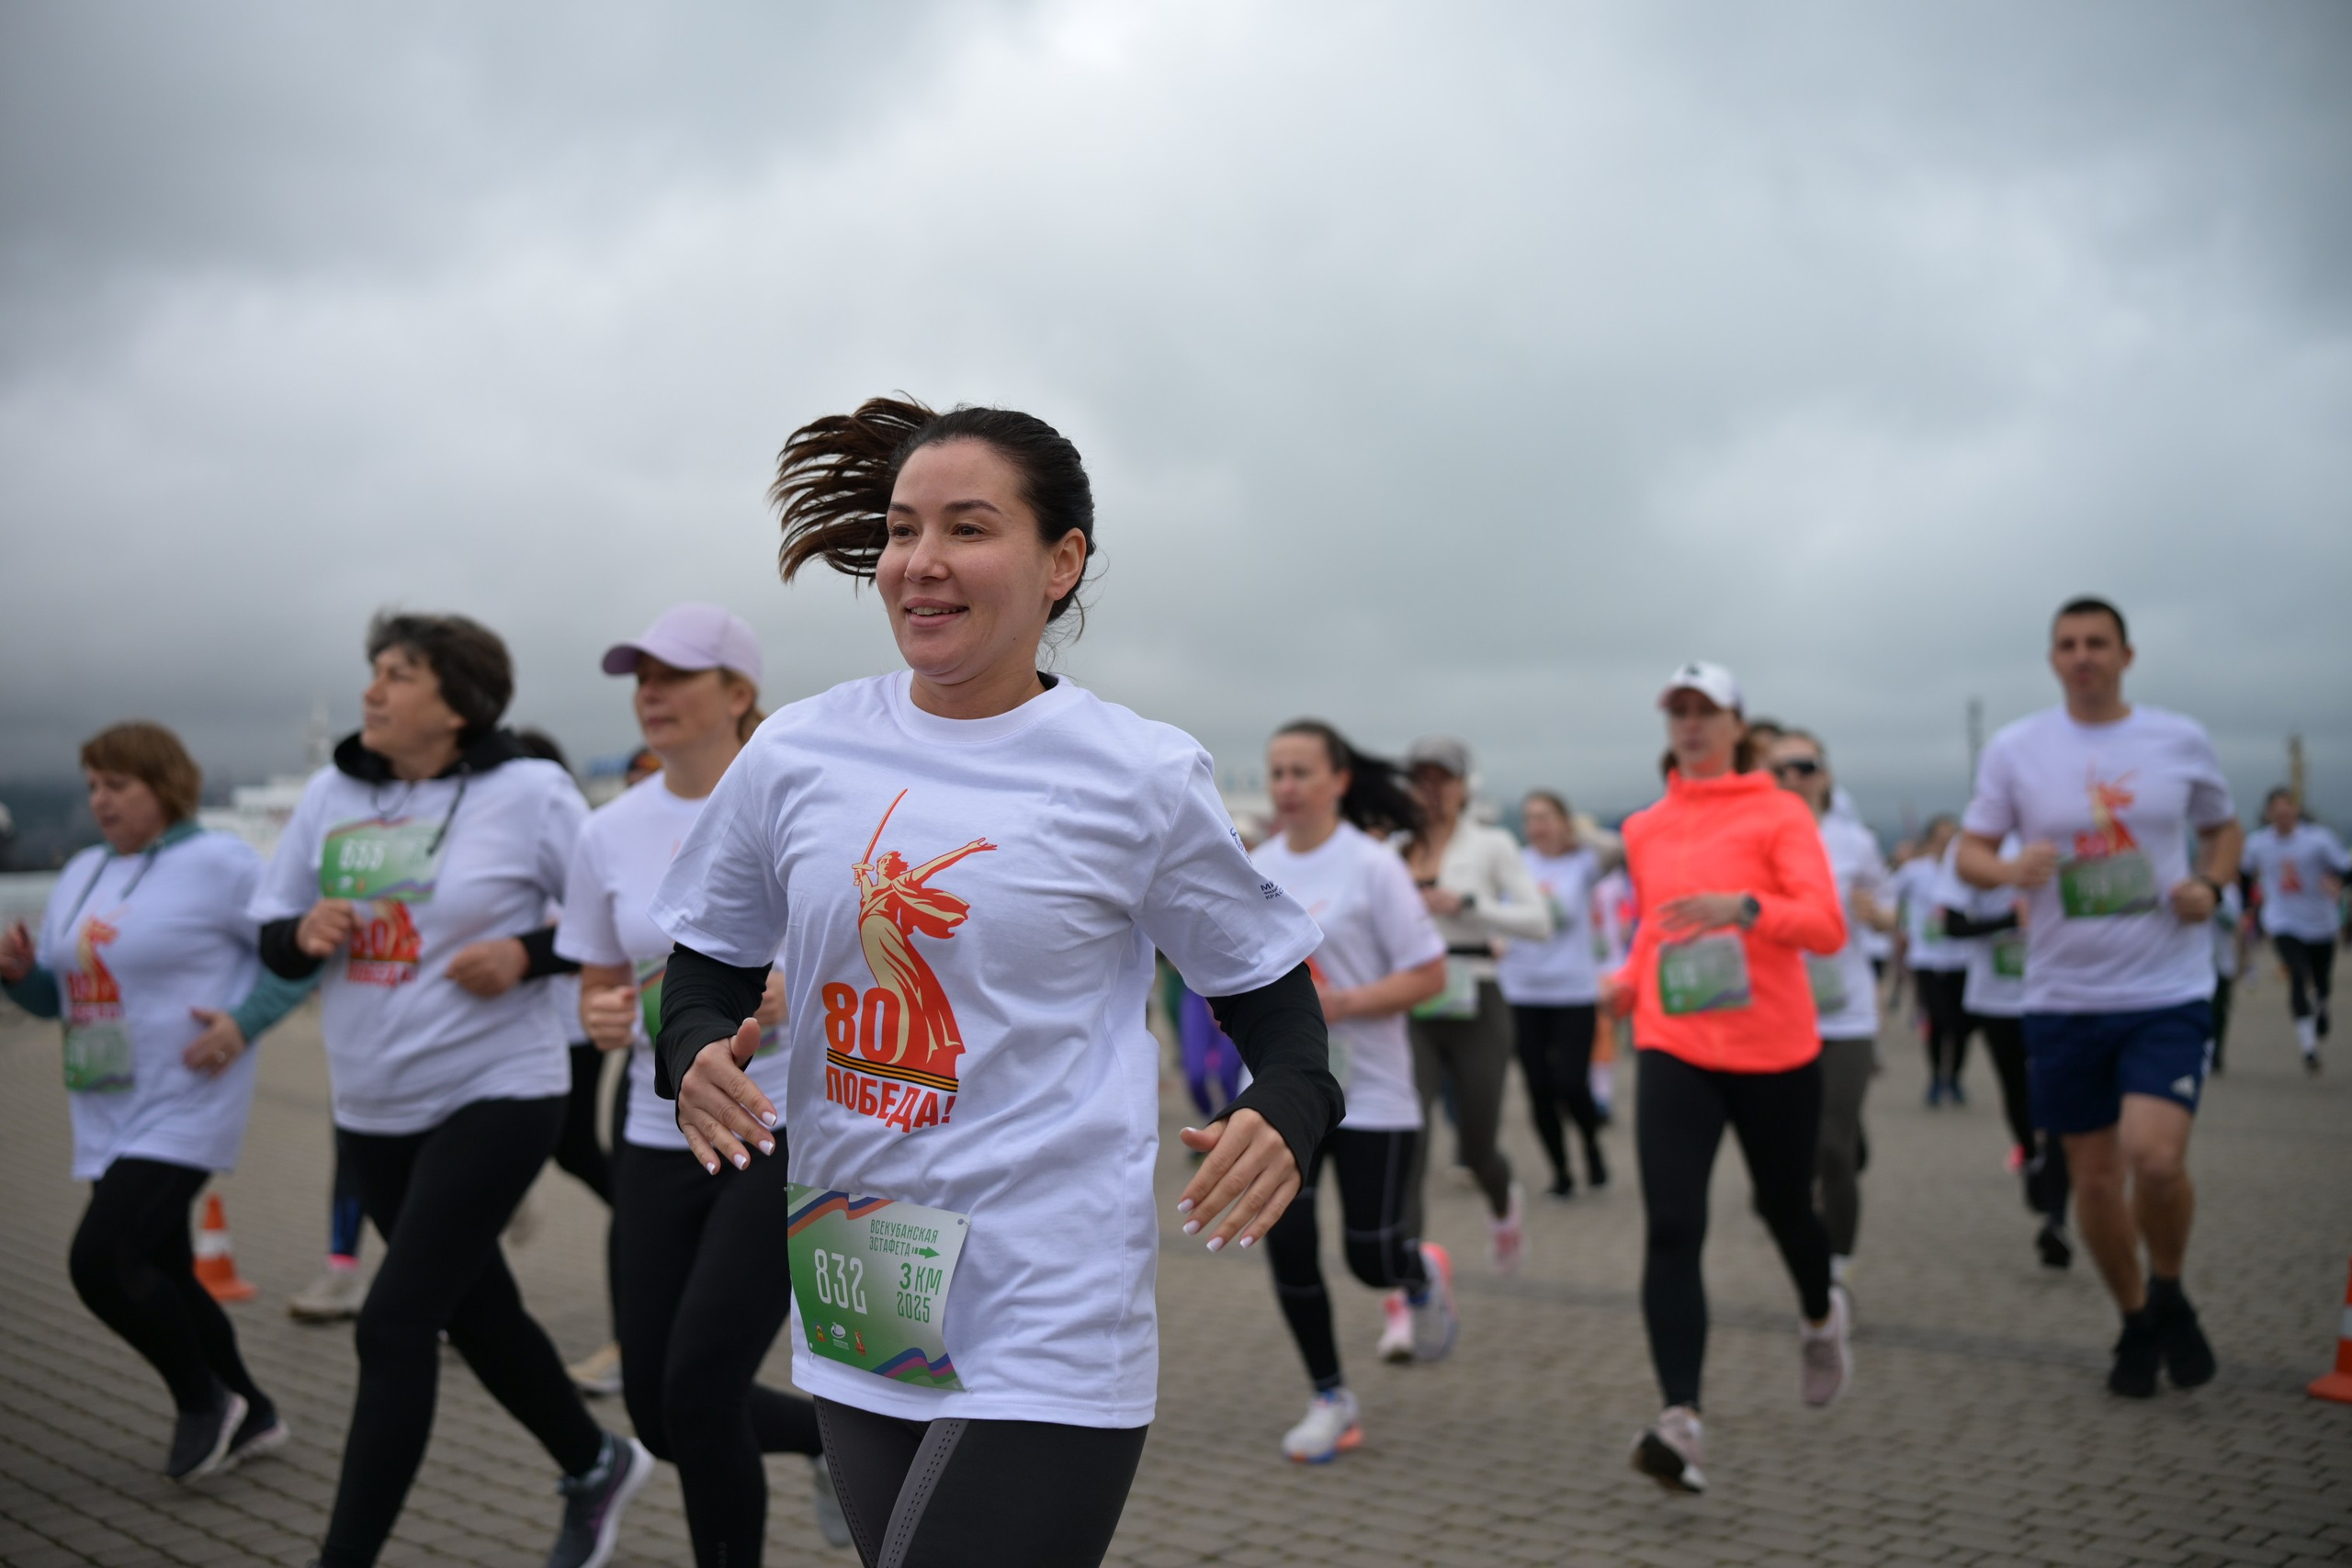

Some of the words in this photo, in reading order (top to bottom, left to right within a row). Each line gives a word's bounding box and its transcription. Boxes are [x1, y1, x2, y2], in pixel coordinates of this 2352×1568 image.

[821, 982, 900, 1065] 80
[826, 1064, 956, 1134] ПОБЕДА!
[868, 1235, 910, 1258] ЭСТАФЕТА
[869, 1218, 939, 1244] ВСЕКУБАНСКАЯ
[814, 1248, 868, 1315] 832
[899, 1262, 912, 1291] 3
[914, 1265, 944, 1296] КМ
[897, 1291, 931, 1324] 2025
